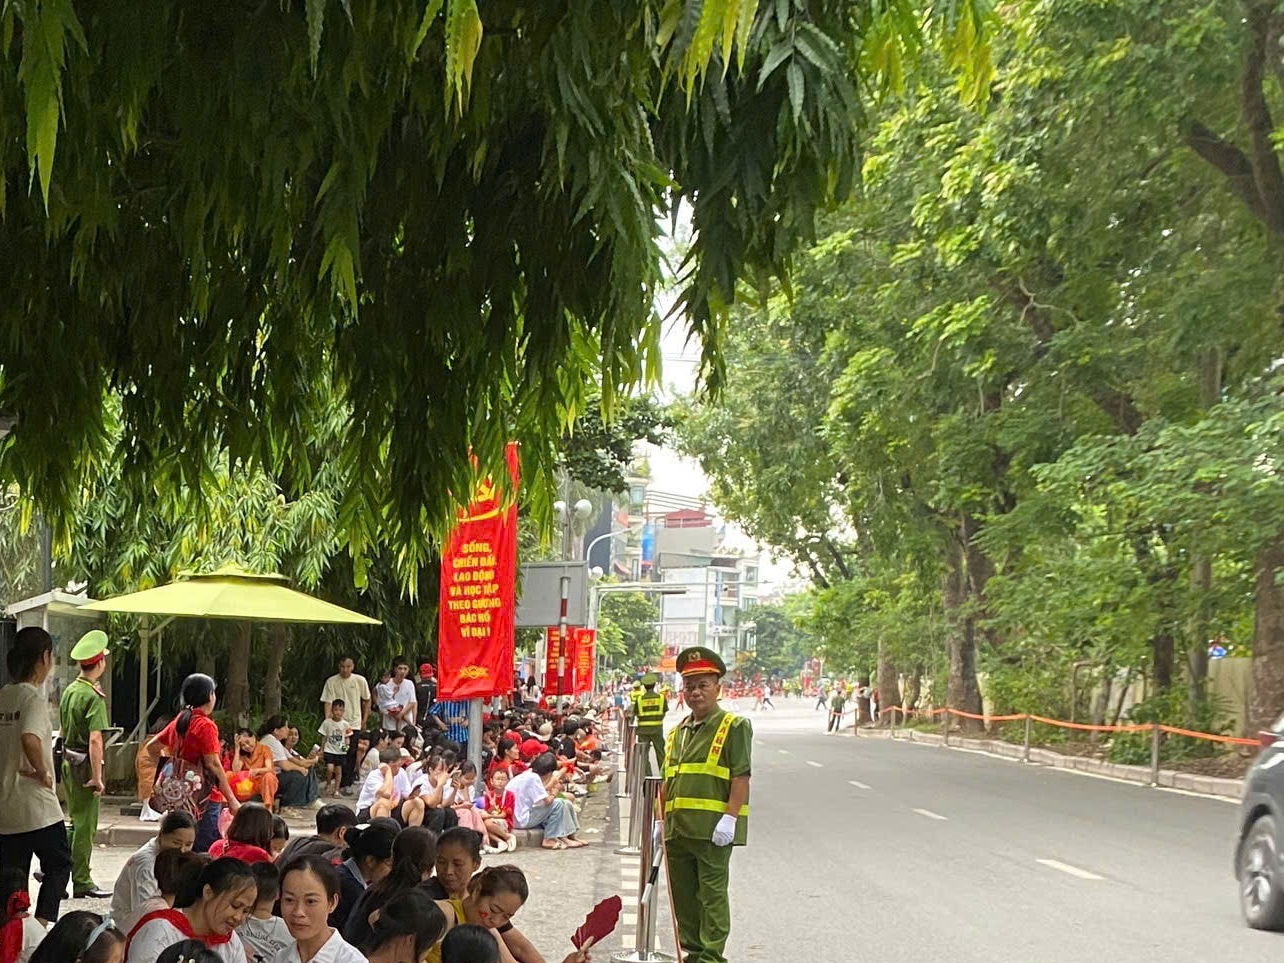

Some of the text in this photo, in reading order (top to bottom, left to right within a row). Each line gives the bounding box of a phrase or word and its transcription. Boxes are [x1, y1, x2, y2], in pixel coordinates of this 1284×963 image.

[453, 571, 471, 582] LAO
[464, 585, 481, 597] HỌC
[448, 600, 471, 610] THEO
[459, 612, 477, 624] BÁC
